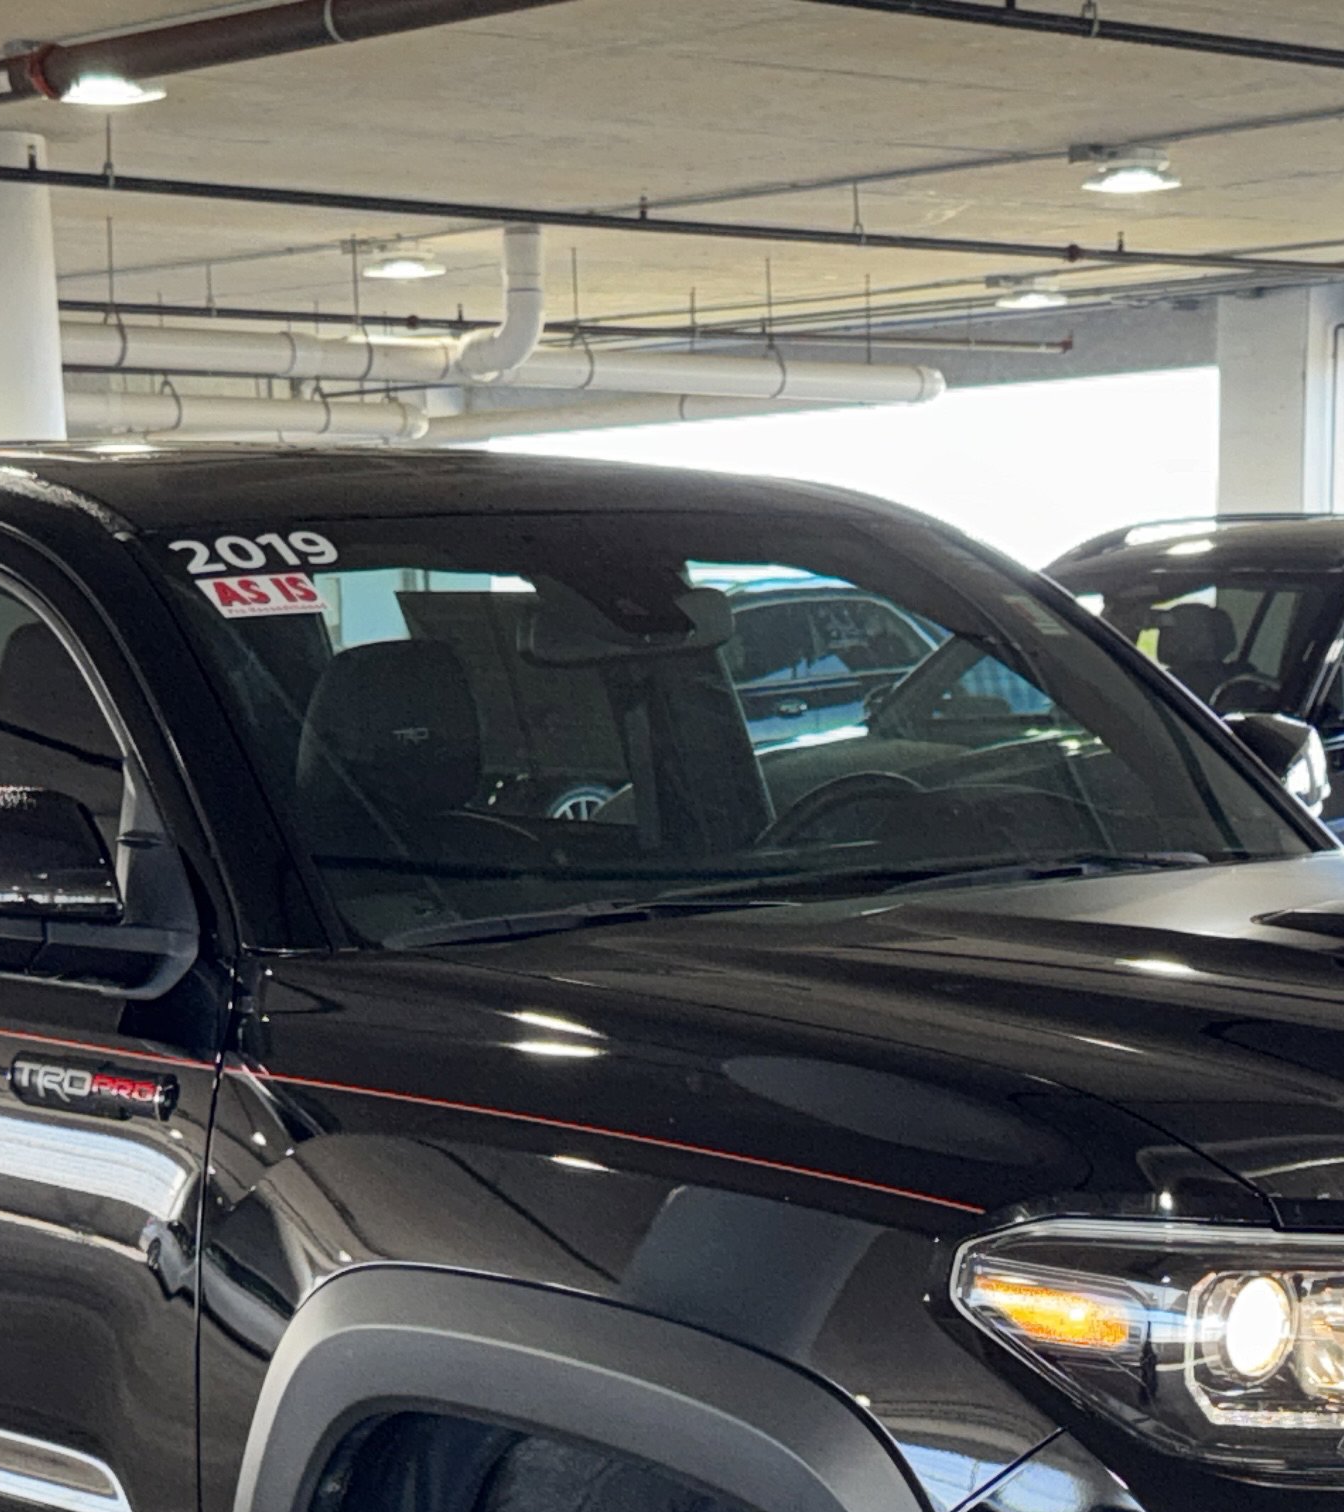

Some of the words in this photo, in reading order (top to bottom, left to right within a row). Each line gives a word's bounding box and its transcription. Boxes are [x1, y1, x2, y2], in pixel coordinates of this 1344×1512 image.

[168, 531, 339, 574] 2019
[212, 580, 271, 607] AS
[270, 577, 318, 603] IS
[14, 1060, 92, 1103] TRD
[91, 1073, 157, 1102] PRO
